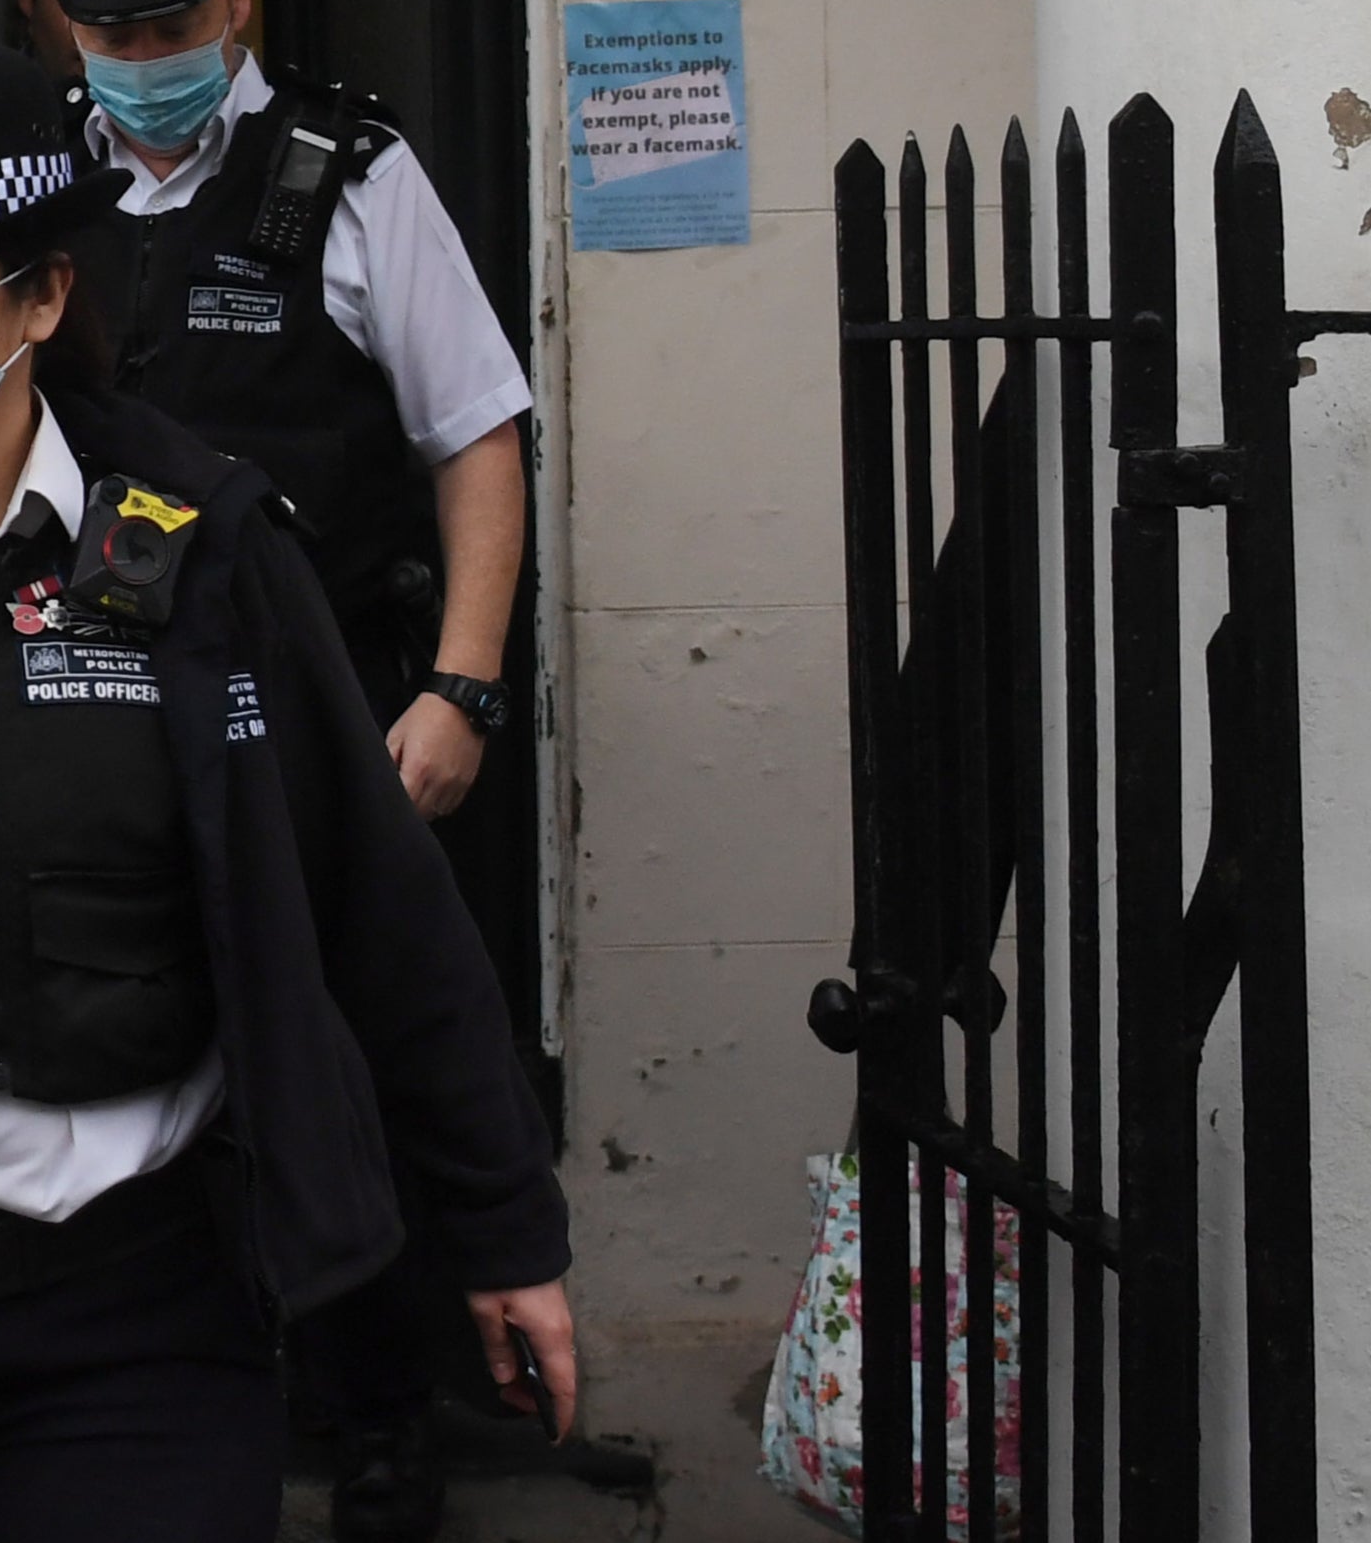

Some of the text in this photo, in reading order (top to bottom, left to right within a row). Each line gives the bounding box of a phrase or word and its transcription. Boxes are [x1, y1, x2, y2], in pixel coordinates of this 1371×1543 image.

[584, 31, 723, 50] Exemptions to
[567, 56, 739, 76] Facemasks apply.
[591, 84, 721, 105] If you are not
[582, 109, 731, 131] exempt, please
[572, 136, 744, 156] wear a facemask.
[231, 302, 269, 313] POLICE
[187, 317, 282, 333] POLICE OFFICER
[85, 660, 142, 672] POLICE
[27, 681, 161, 703] POLICE OFFICER
